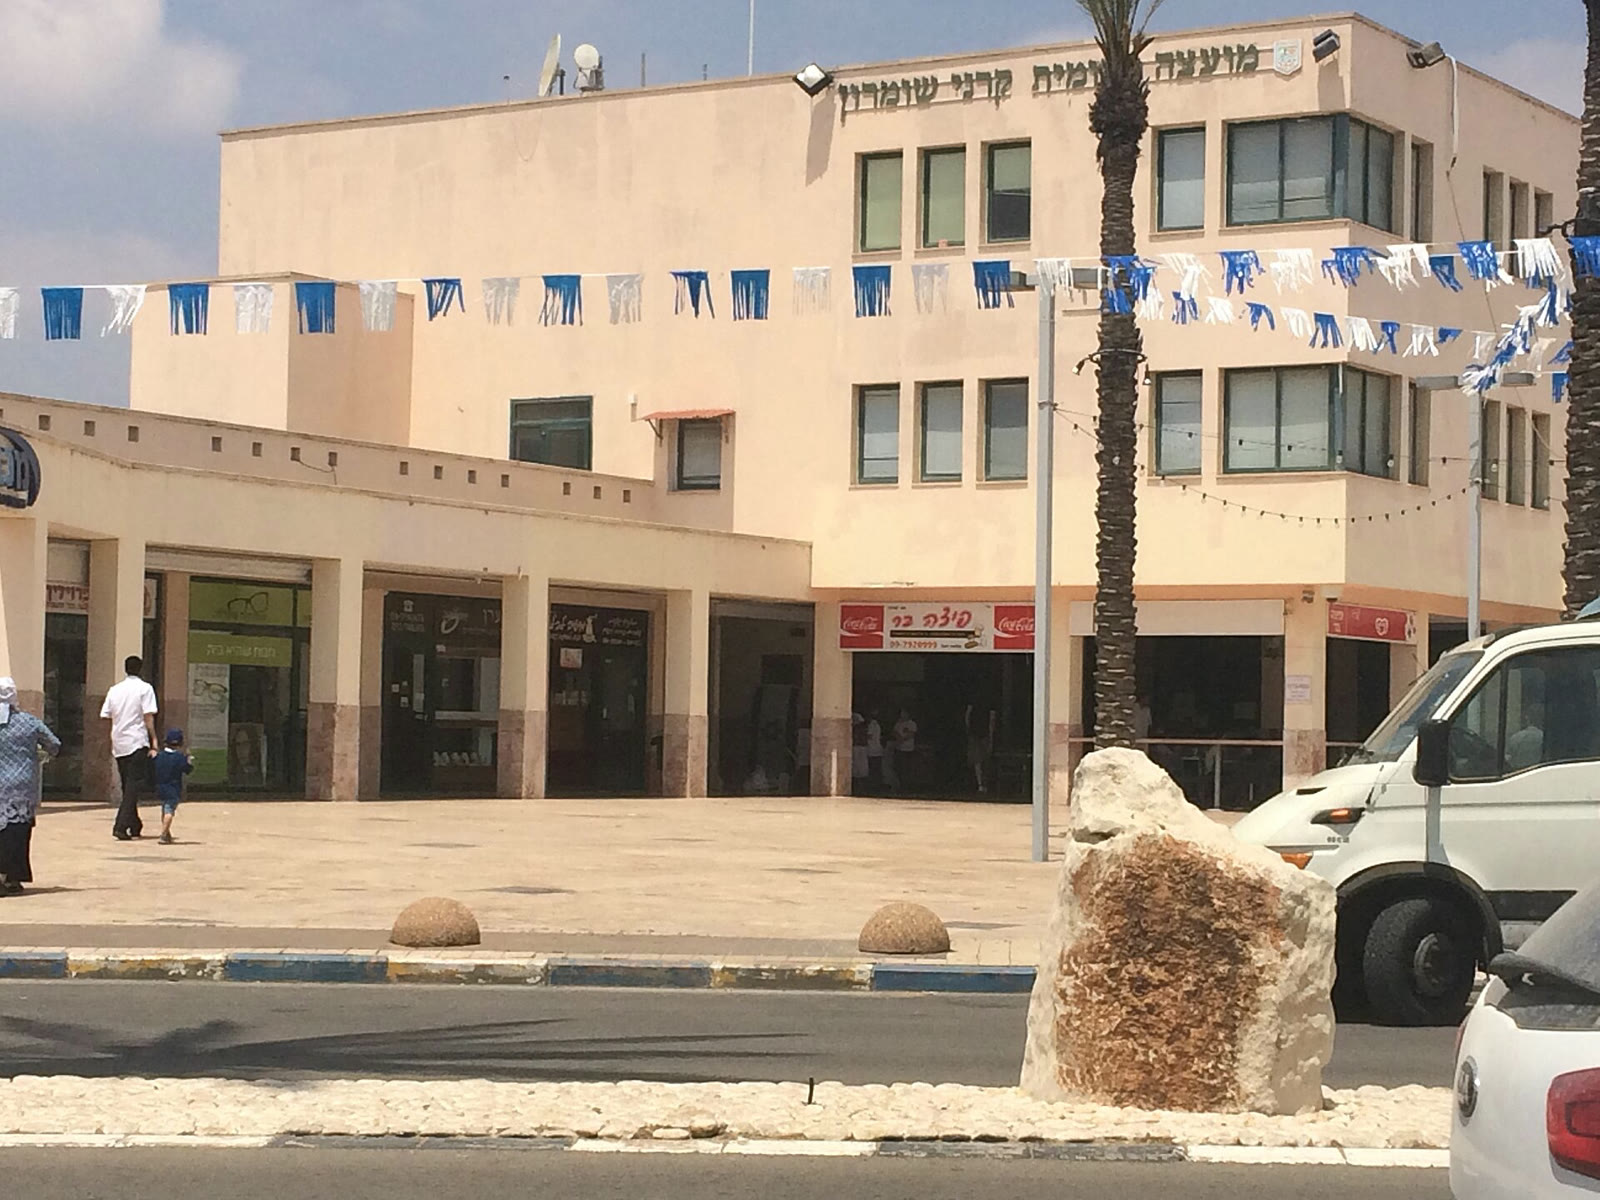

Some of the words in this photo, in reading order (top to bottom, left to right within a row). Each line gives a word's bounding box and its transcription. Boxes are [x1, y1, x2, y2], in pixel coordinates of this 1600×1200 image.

[1032, 60, 1104, 92] ומית
[1155, 44, 1259, 80] מועצה
[839, 75, 939, 127] שומרון
[951, 69, 1012, 110] קרני
[922, 606, 972, 628] פיצה
